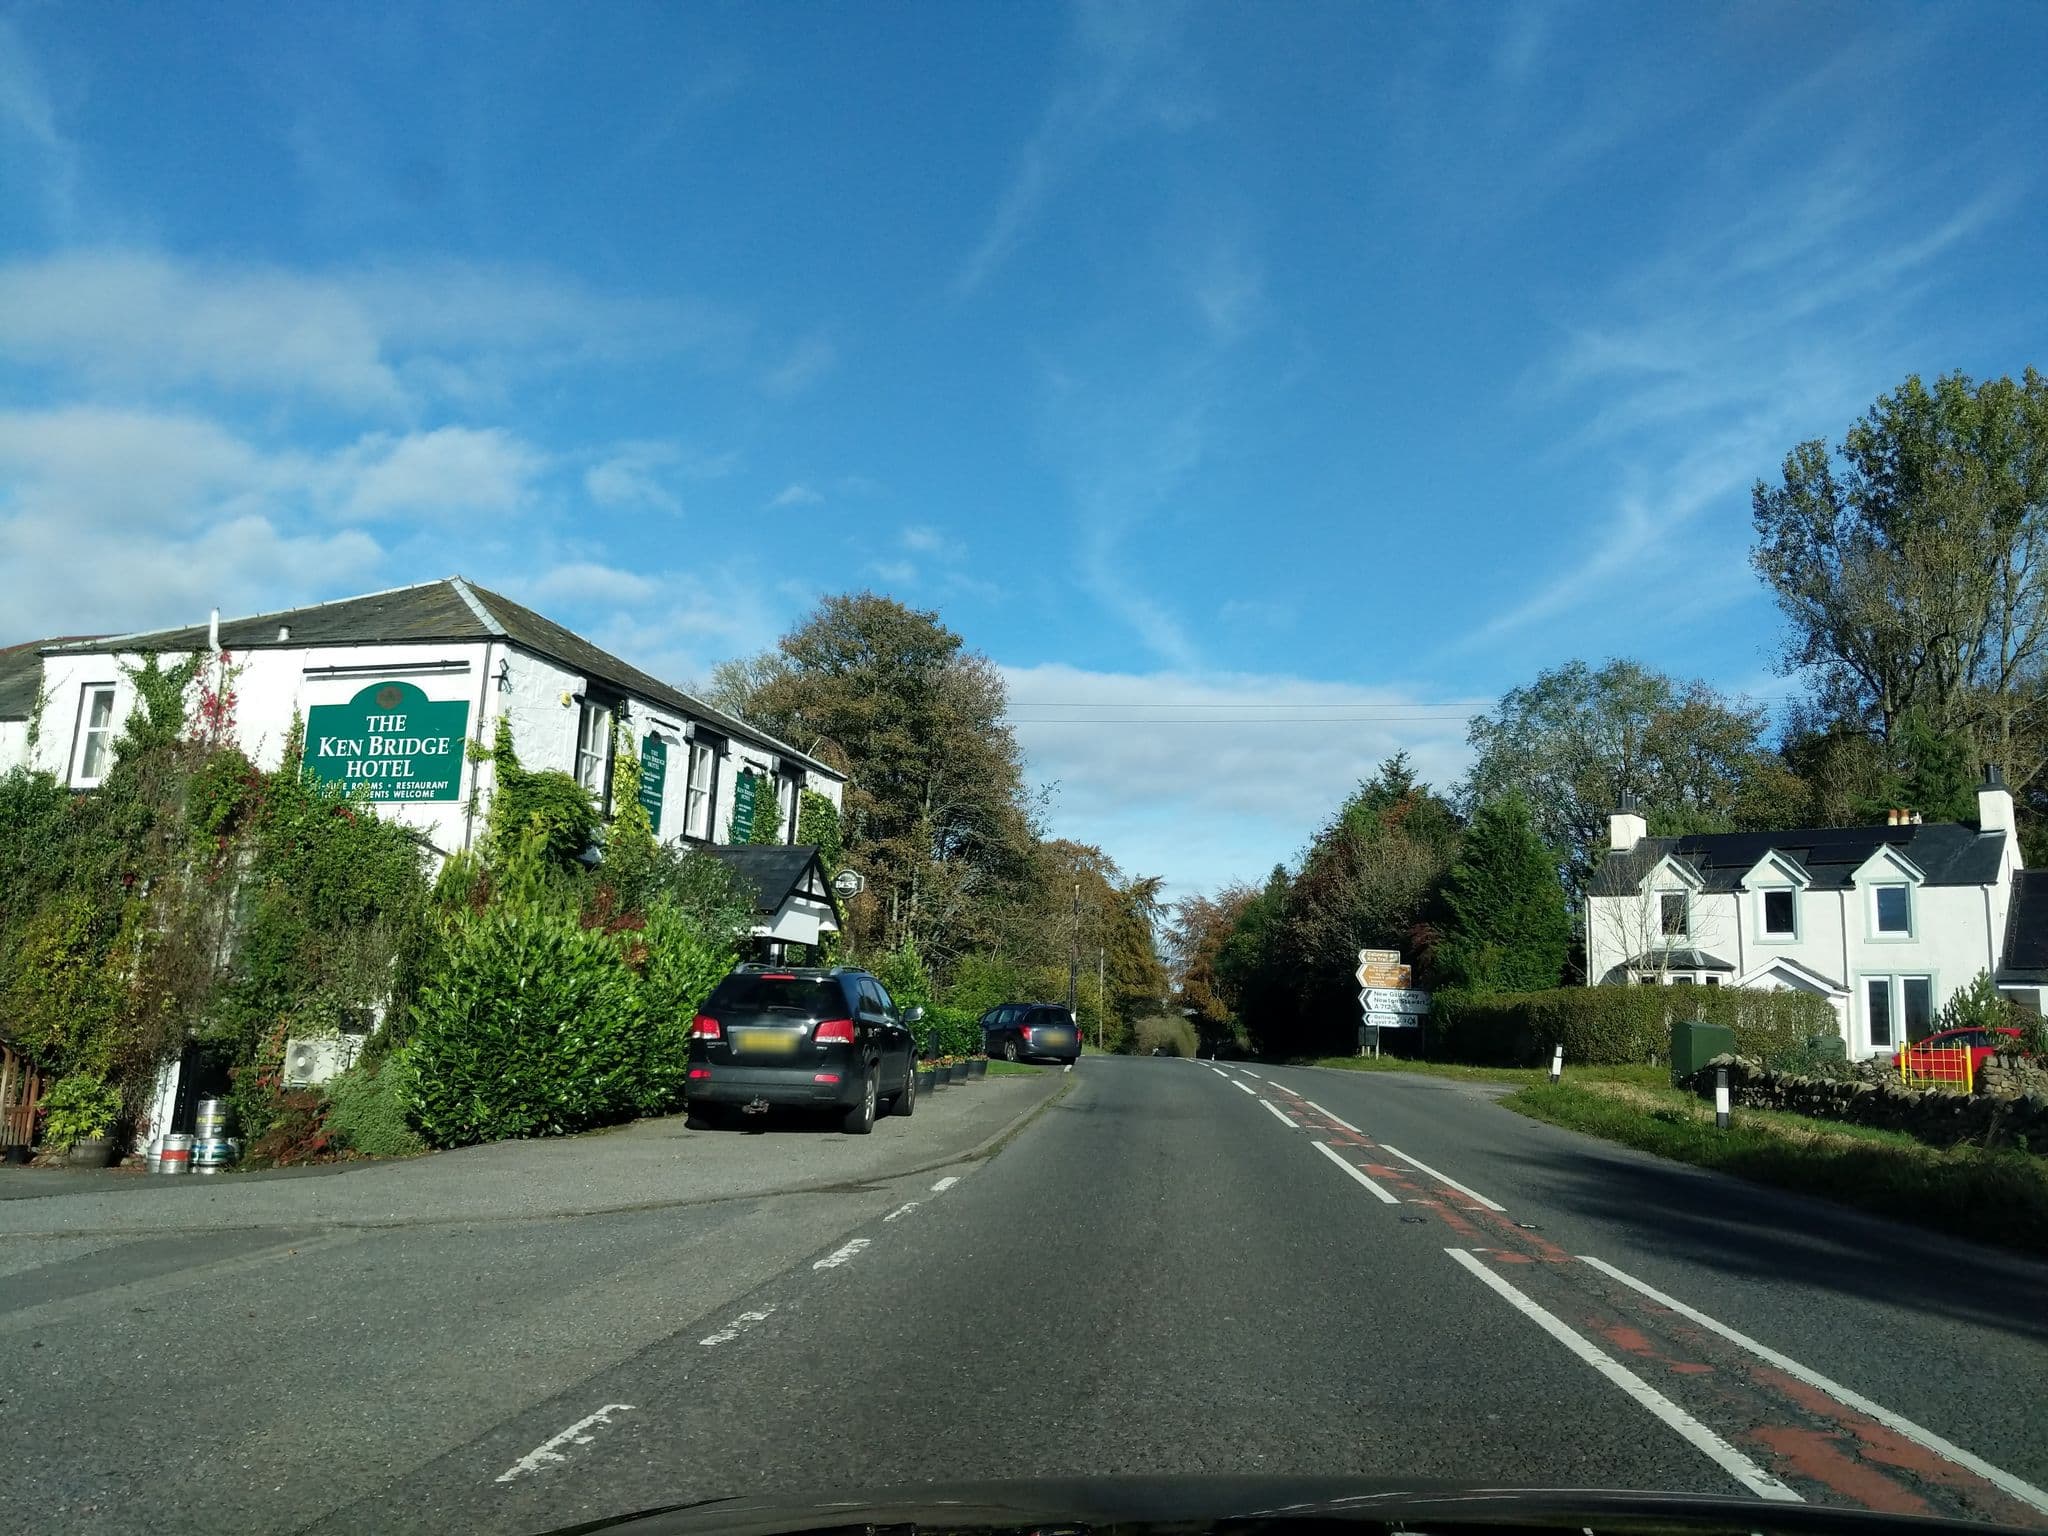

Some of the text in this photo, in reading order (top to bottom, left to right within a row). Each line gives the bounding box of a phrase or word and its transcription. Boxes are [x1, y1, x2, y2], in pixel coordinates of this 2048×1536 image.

[366, 714, 408, 733] THE
[317, 735, 450, 757] KEN BRIDGE
[345, 760, 415, 778] HOTEL
[393, 789, 435, 798] WELCOME
[396, 781, 449, 790] RESTAURANT
